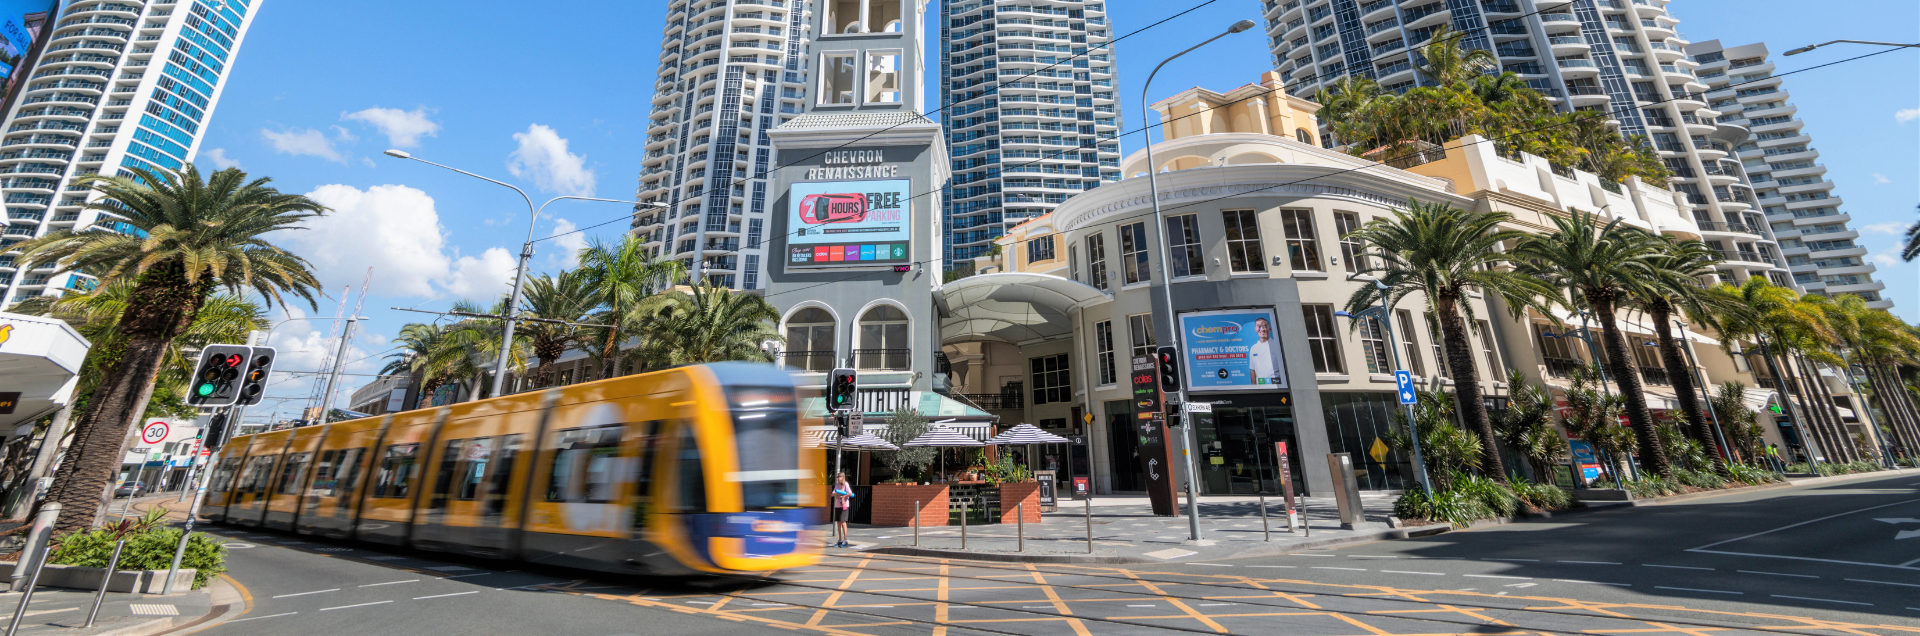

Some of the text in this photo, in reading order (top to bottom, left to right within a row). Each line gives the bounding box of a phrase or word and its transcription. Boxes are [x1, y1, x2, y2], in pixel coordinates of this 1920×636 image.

[4, 20, 29, 50] FOR SALE
[824, 150, 883, 164] CHEVRON
[808, 165, 898, 180] RENAISSANCE
[866, 192, 900, 209] FREE
[805, 200, 859, 218] 2 HOURS
[866, 210, 900, 222] PARKING
[1196, 325, 1238, 335] chempro
[1191, 346, 1218, 354] PHARMACY
[1225, 345, 1249, 353] DOCTORS
[1134, 374, 1152, 384] coles
[1398, 373, 1409, 388] P
[147, 428, 164, 438] 30
